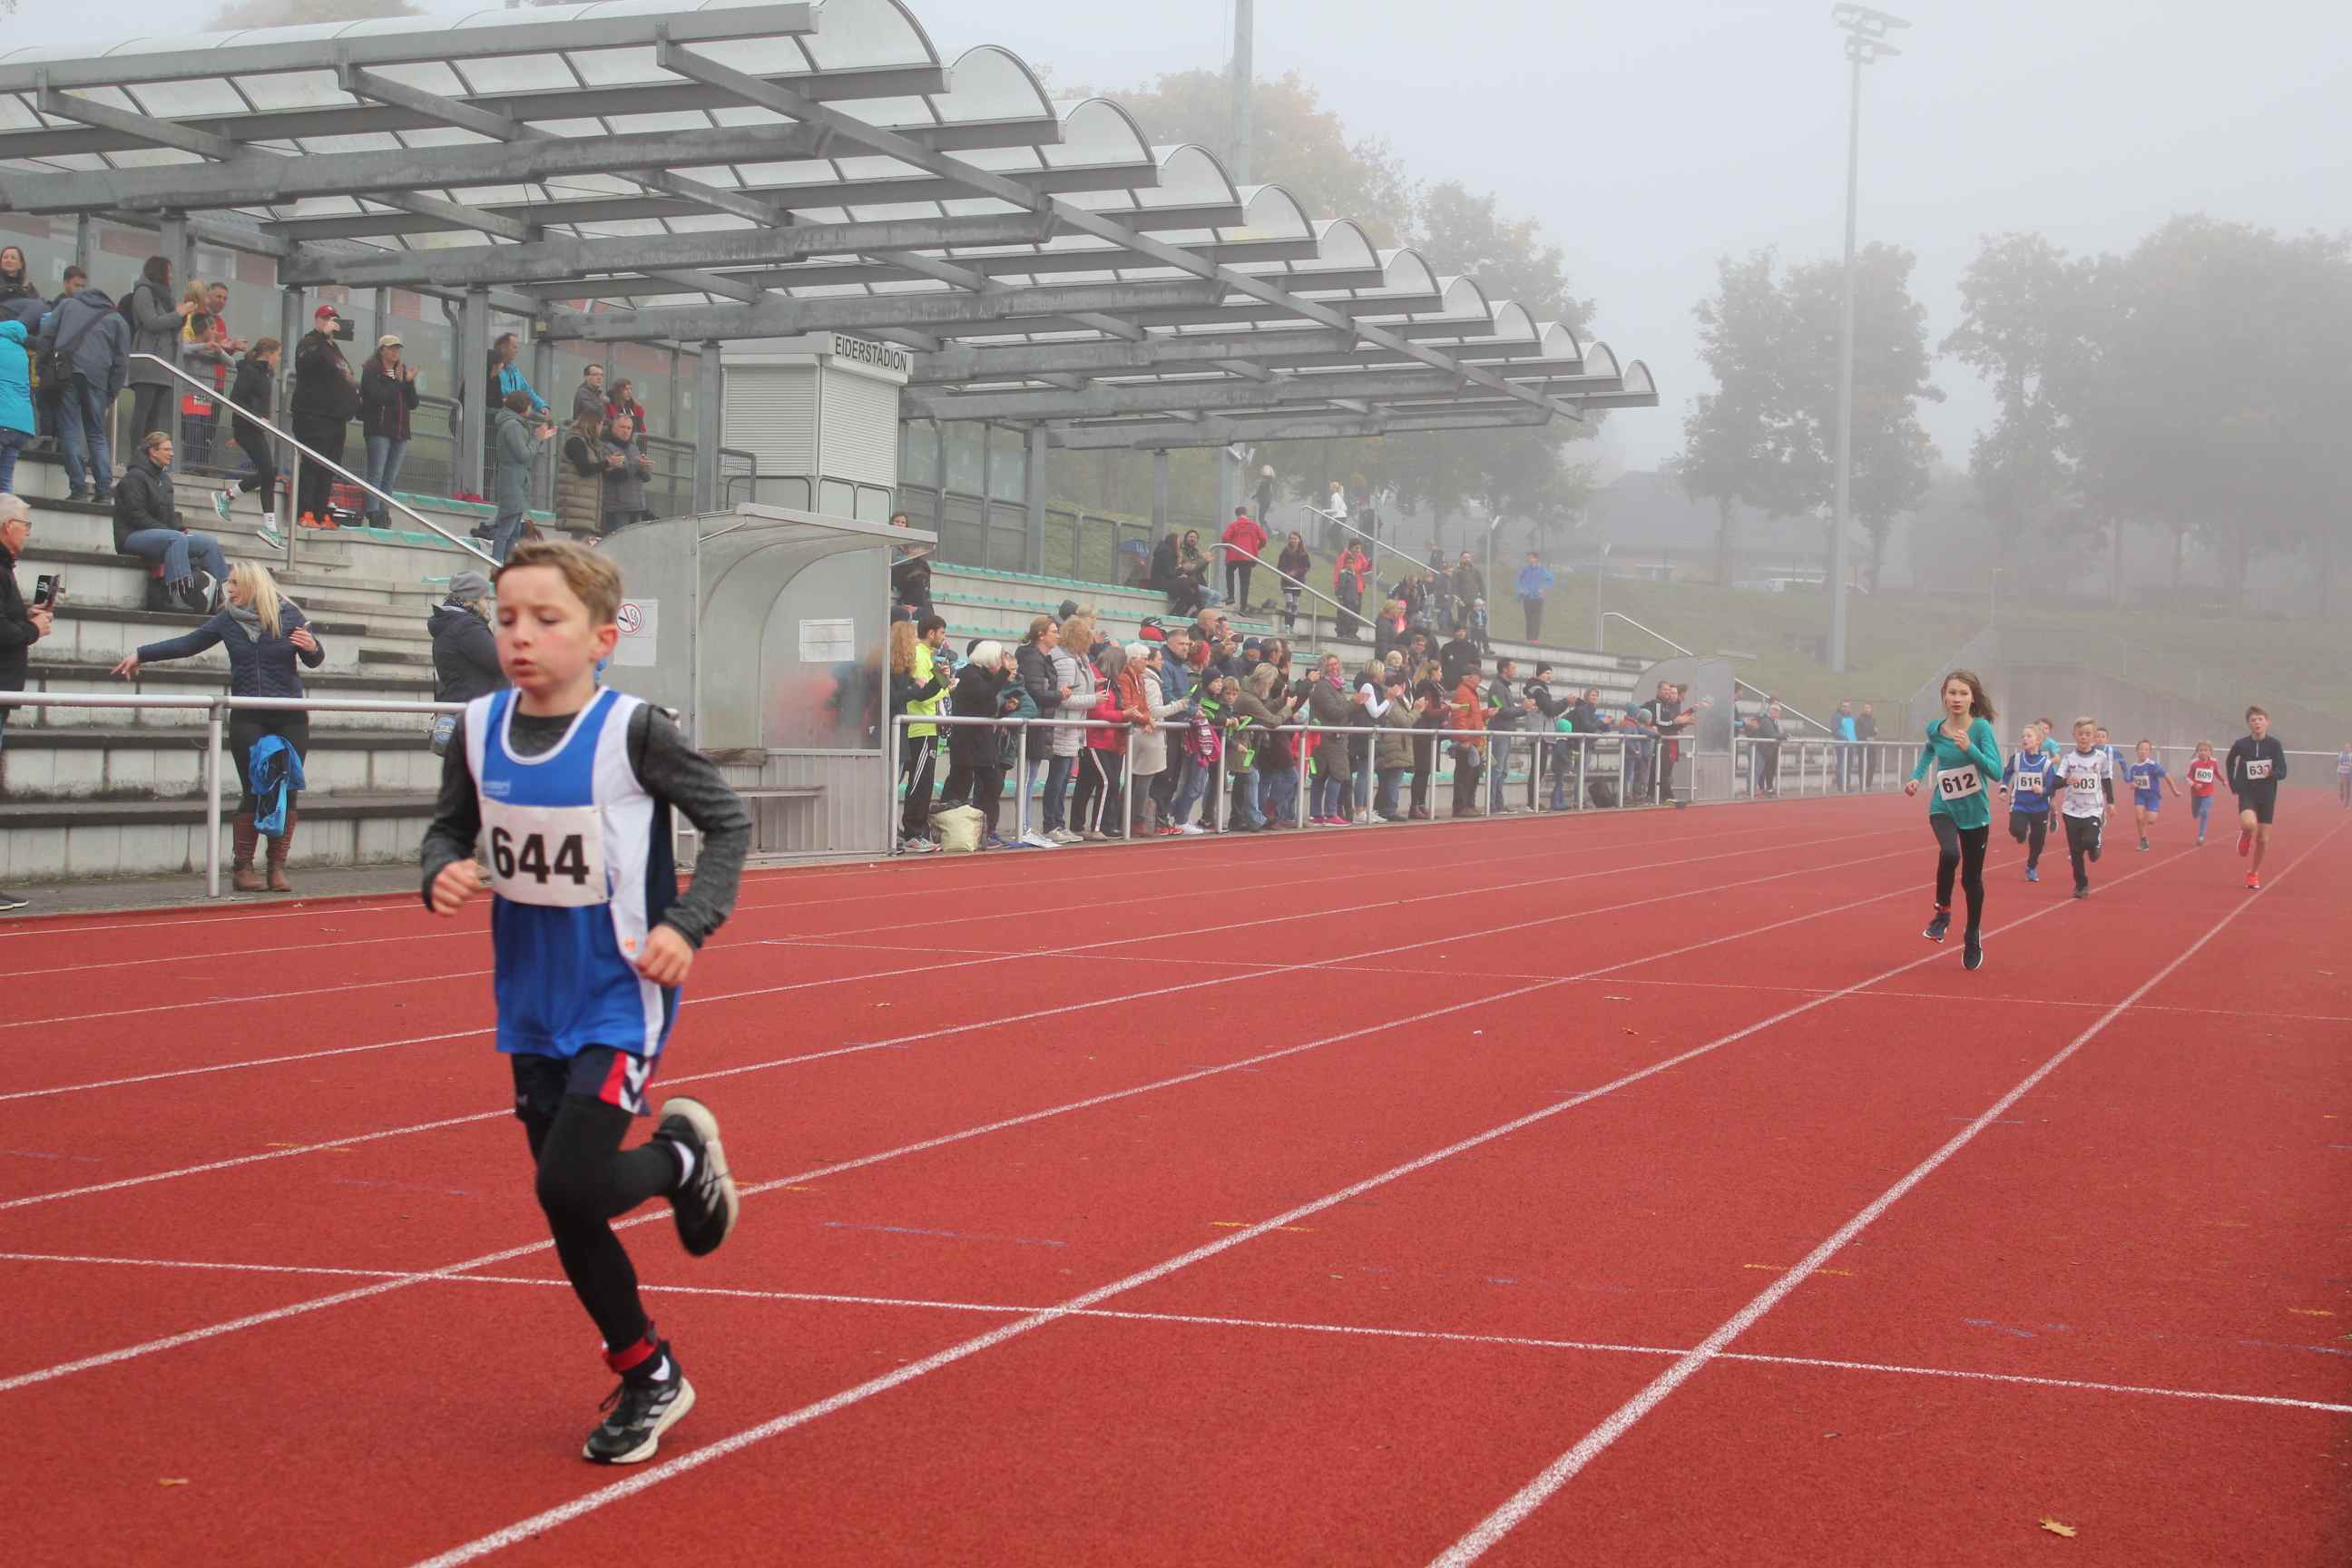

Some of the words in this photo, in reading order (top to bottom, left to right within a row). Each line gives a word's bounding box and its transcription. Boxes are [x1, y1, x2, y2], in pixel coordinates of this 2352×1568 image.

[835, 336, 907, 372] EIDERSTADION
[1942, 772, 1976, 794] 612
[491, 827, 589, 886] 644
